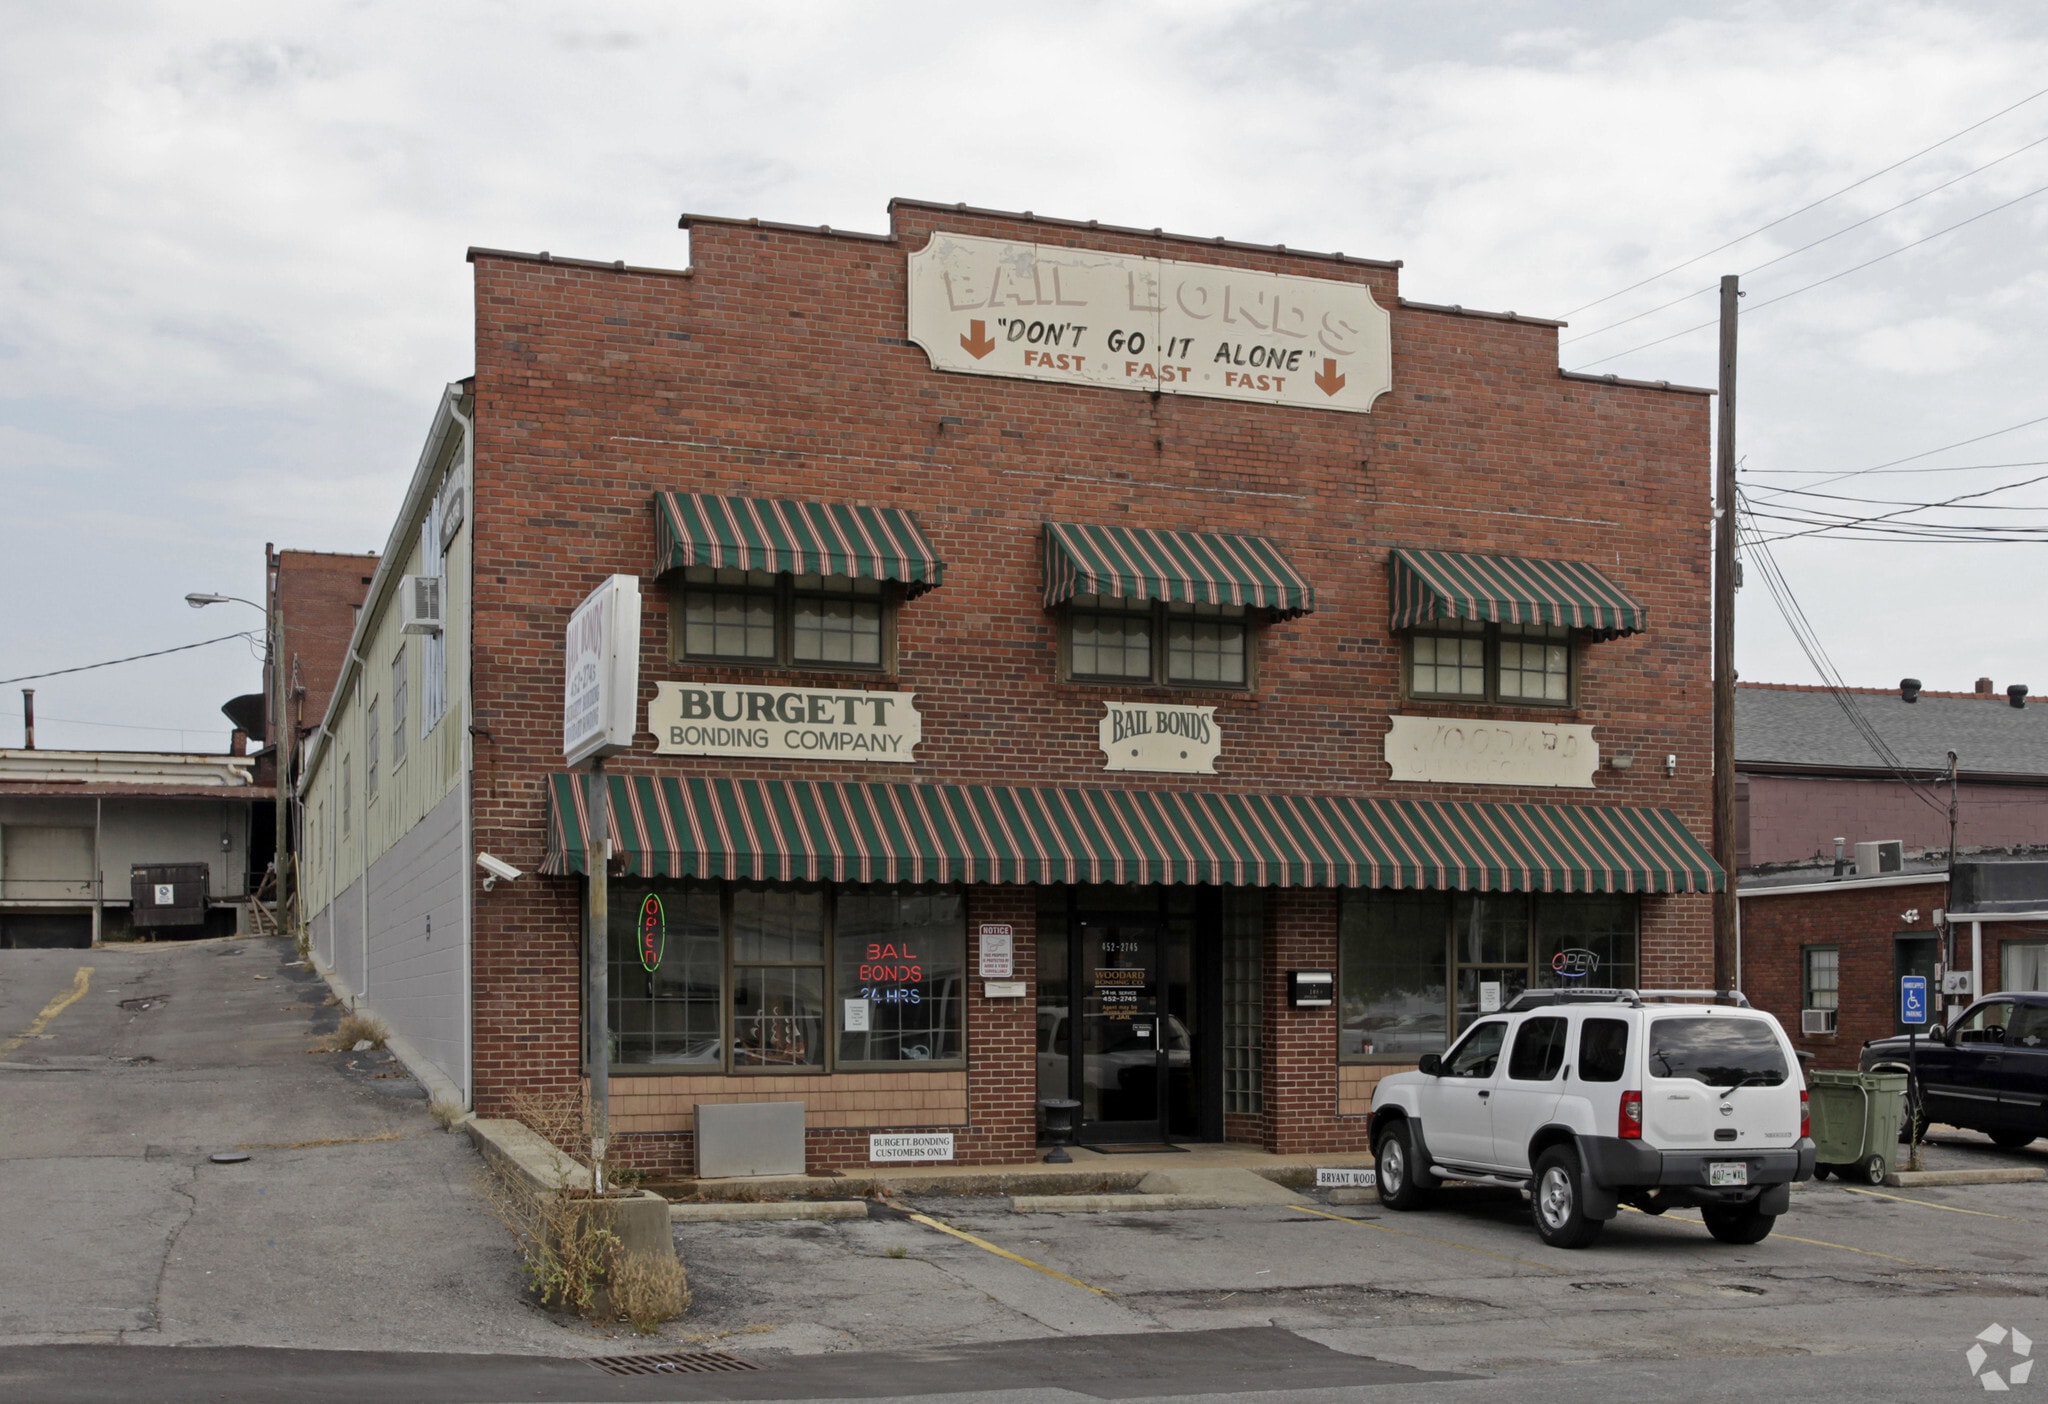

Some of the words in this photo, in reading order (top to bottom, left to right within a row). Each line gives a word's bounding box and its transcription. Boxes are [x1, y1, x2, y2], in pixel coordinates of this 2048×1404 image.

[1107, 329, 1145, 354] GO
[1167, 336, 1195, 360] IT
[1024, 350, 1086, 372] FAST
[1125, 361, 1192, 382] FAST
[1225, 371, 1286, 393] FAST
[678, 689, 895, 726] BURGETT
[1111, 709, 1152, 744] BAIL
[1155, 711, 1210, 744] BONDS
[670, 726, 769, 748] BONDING
[784, 729, 903, 753] COMPANY
[983, 926, 1009, 935] NOTICE
[1552, 952, 1600, 973] OPEN
[859, 964, 922, 983] BONDS
[1094, 971, 1145, 979] WOODARD
[861, 987, 882, 1004] 24
[886, 988, 921, 1005] HRS
[913, 1137, 950, 1146] BONDING
[876, 1148, 925, 1157] CUSTOMERS
[927, 1147, 948, 1156] ONLY
[1321, 1173, 1349, 1183] BRYANT
